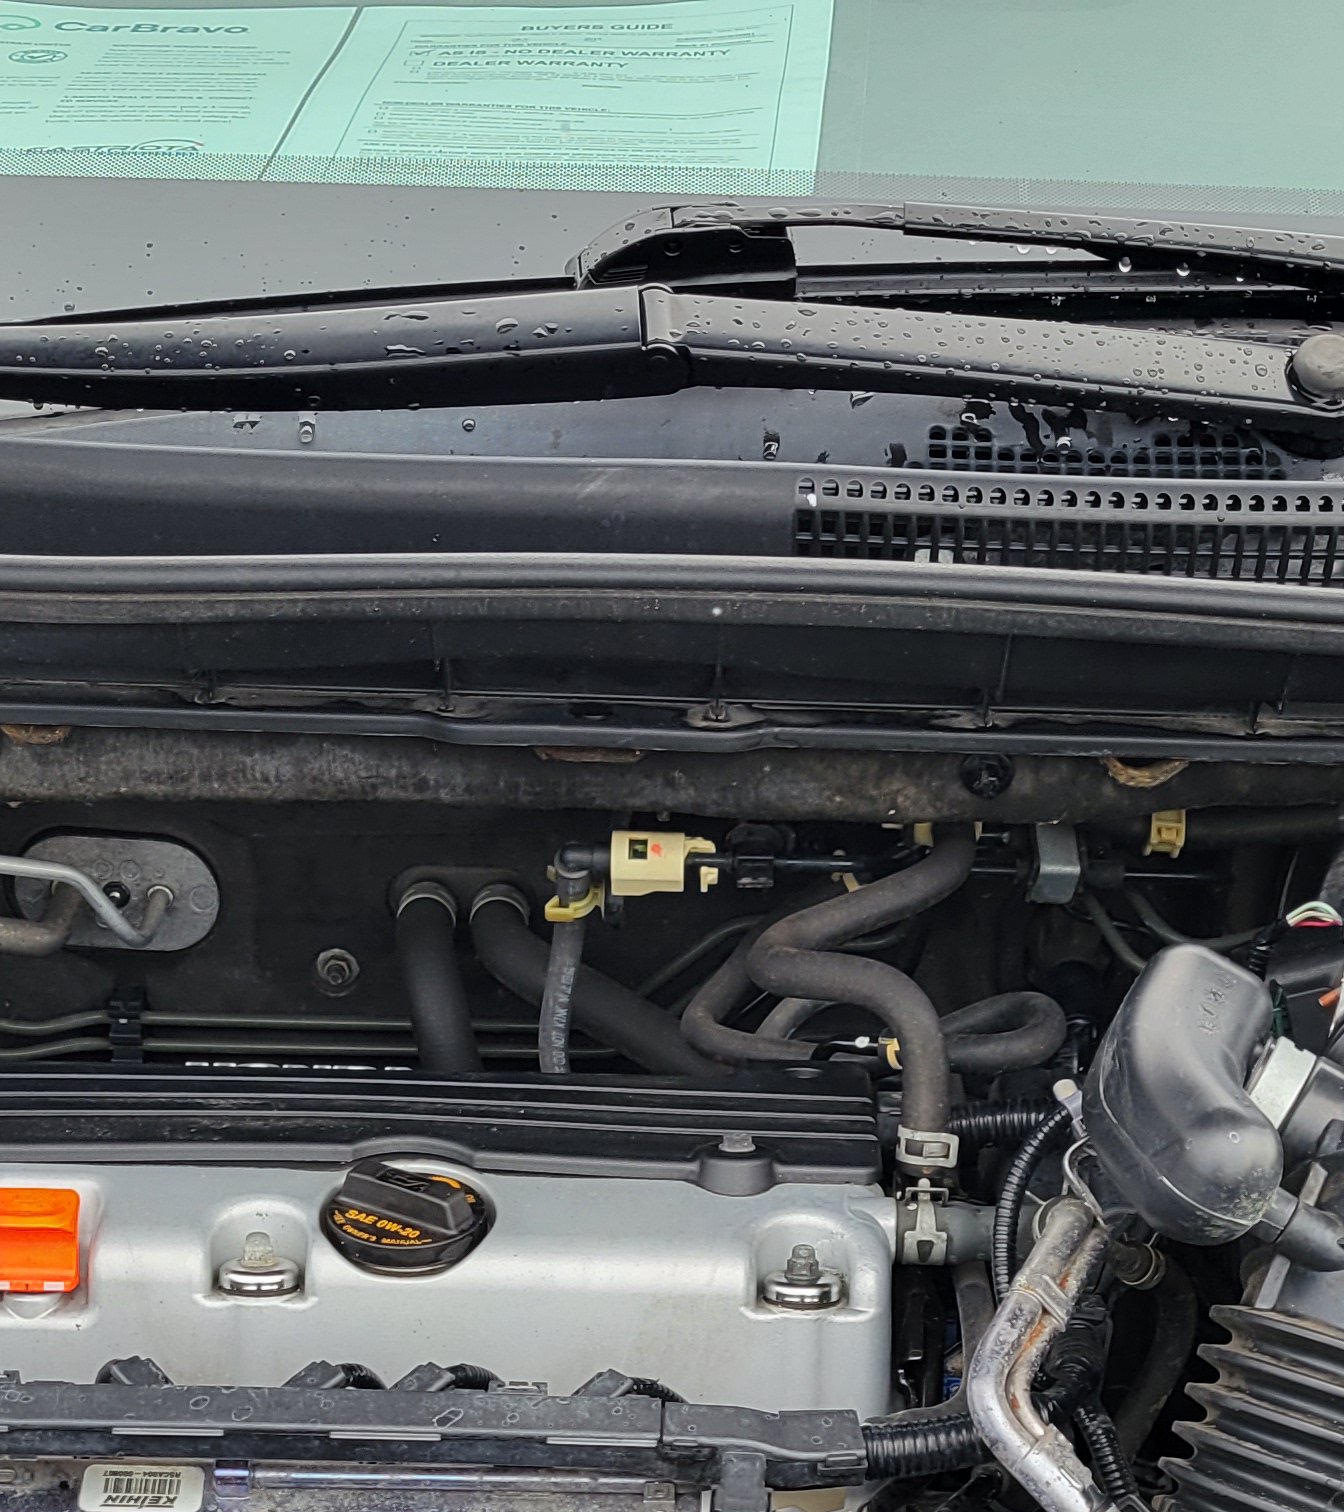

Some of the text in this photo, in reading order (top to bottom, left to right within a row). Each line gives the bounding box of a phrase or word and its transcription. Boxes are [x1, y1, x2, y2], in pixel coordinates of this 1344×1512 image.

[54, 21, 249, 34] CarBravo
[621, 49, 731, 57] WARRANTY
[516, 60, 629, 68] WARRANTY
[344, 1209, 379, 1225] SAE
[375, 1219, 421, 1239] 0W-20
[102, 1495, 178, 1510] KEIHIN
